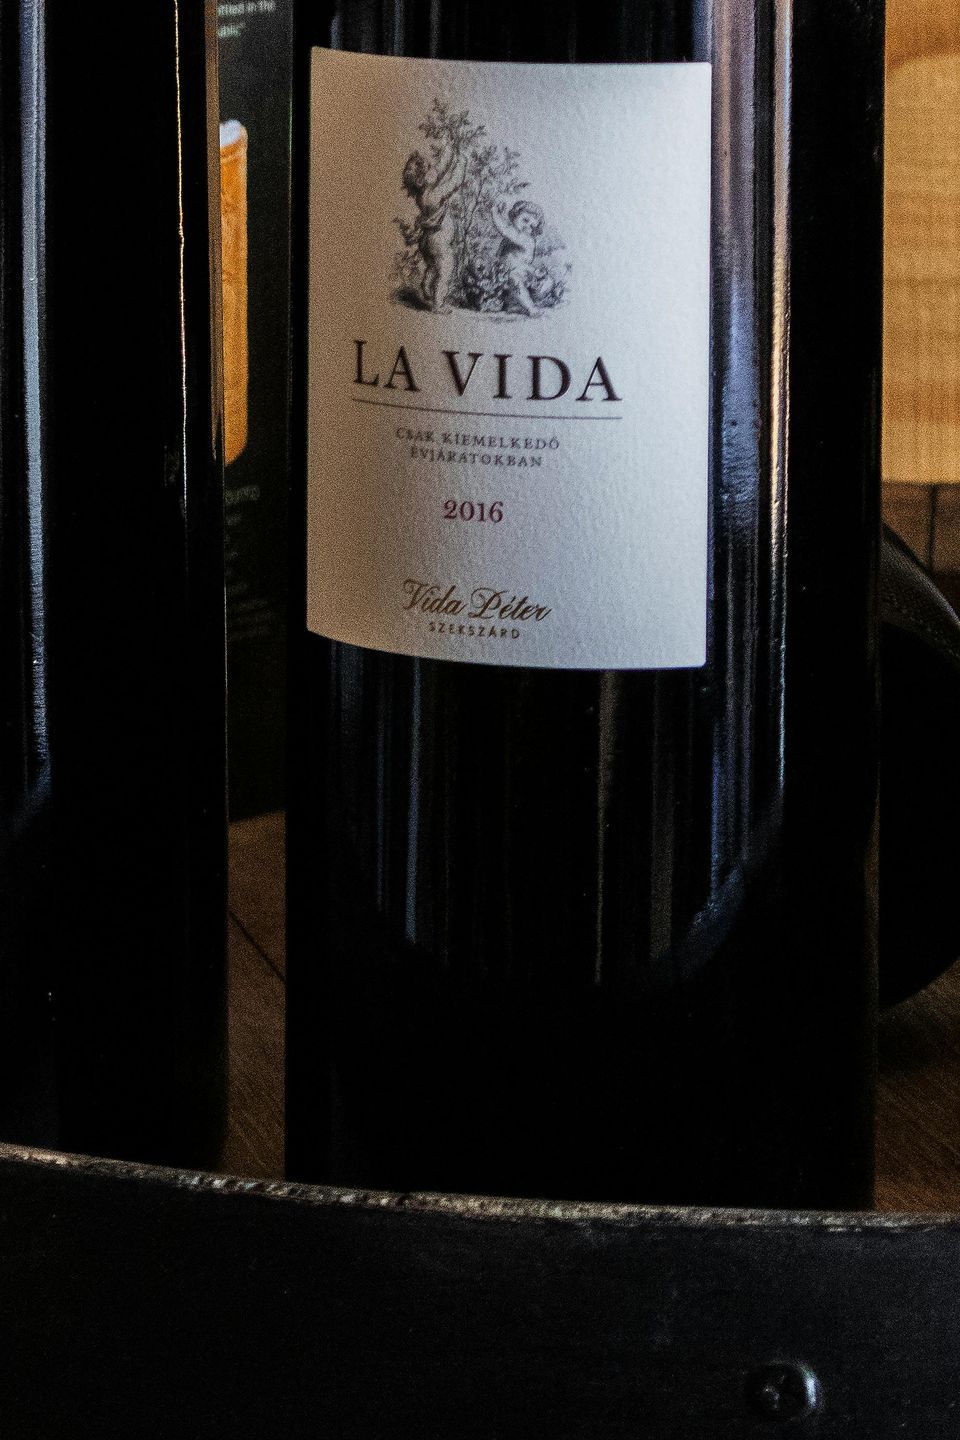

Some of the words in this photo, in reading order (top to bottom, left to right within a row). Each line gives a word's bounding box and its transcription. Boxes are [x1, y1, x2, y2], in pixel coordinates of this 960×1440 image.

[353, 339, 420, 394] LA
[442, 350, 622, 402] VIDA
[395, 426, 436, 444] CSAK
[443, 499, 505, 523] 2016
[401, 578, 467, 616] Vida
[467, 587, 553, 623] Péter
